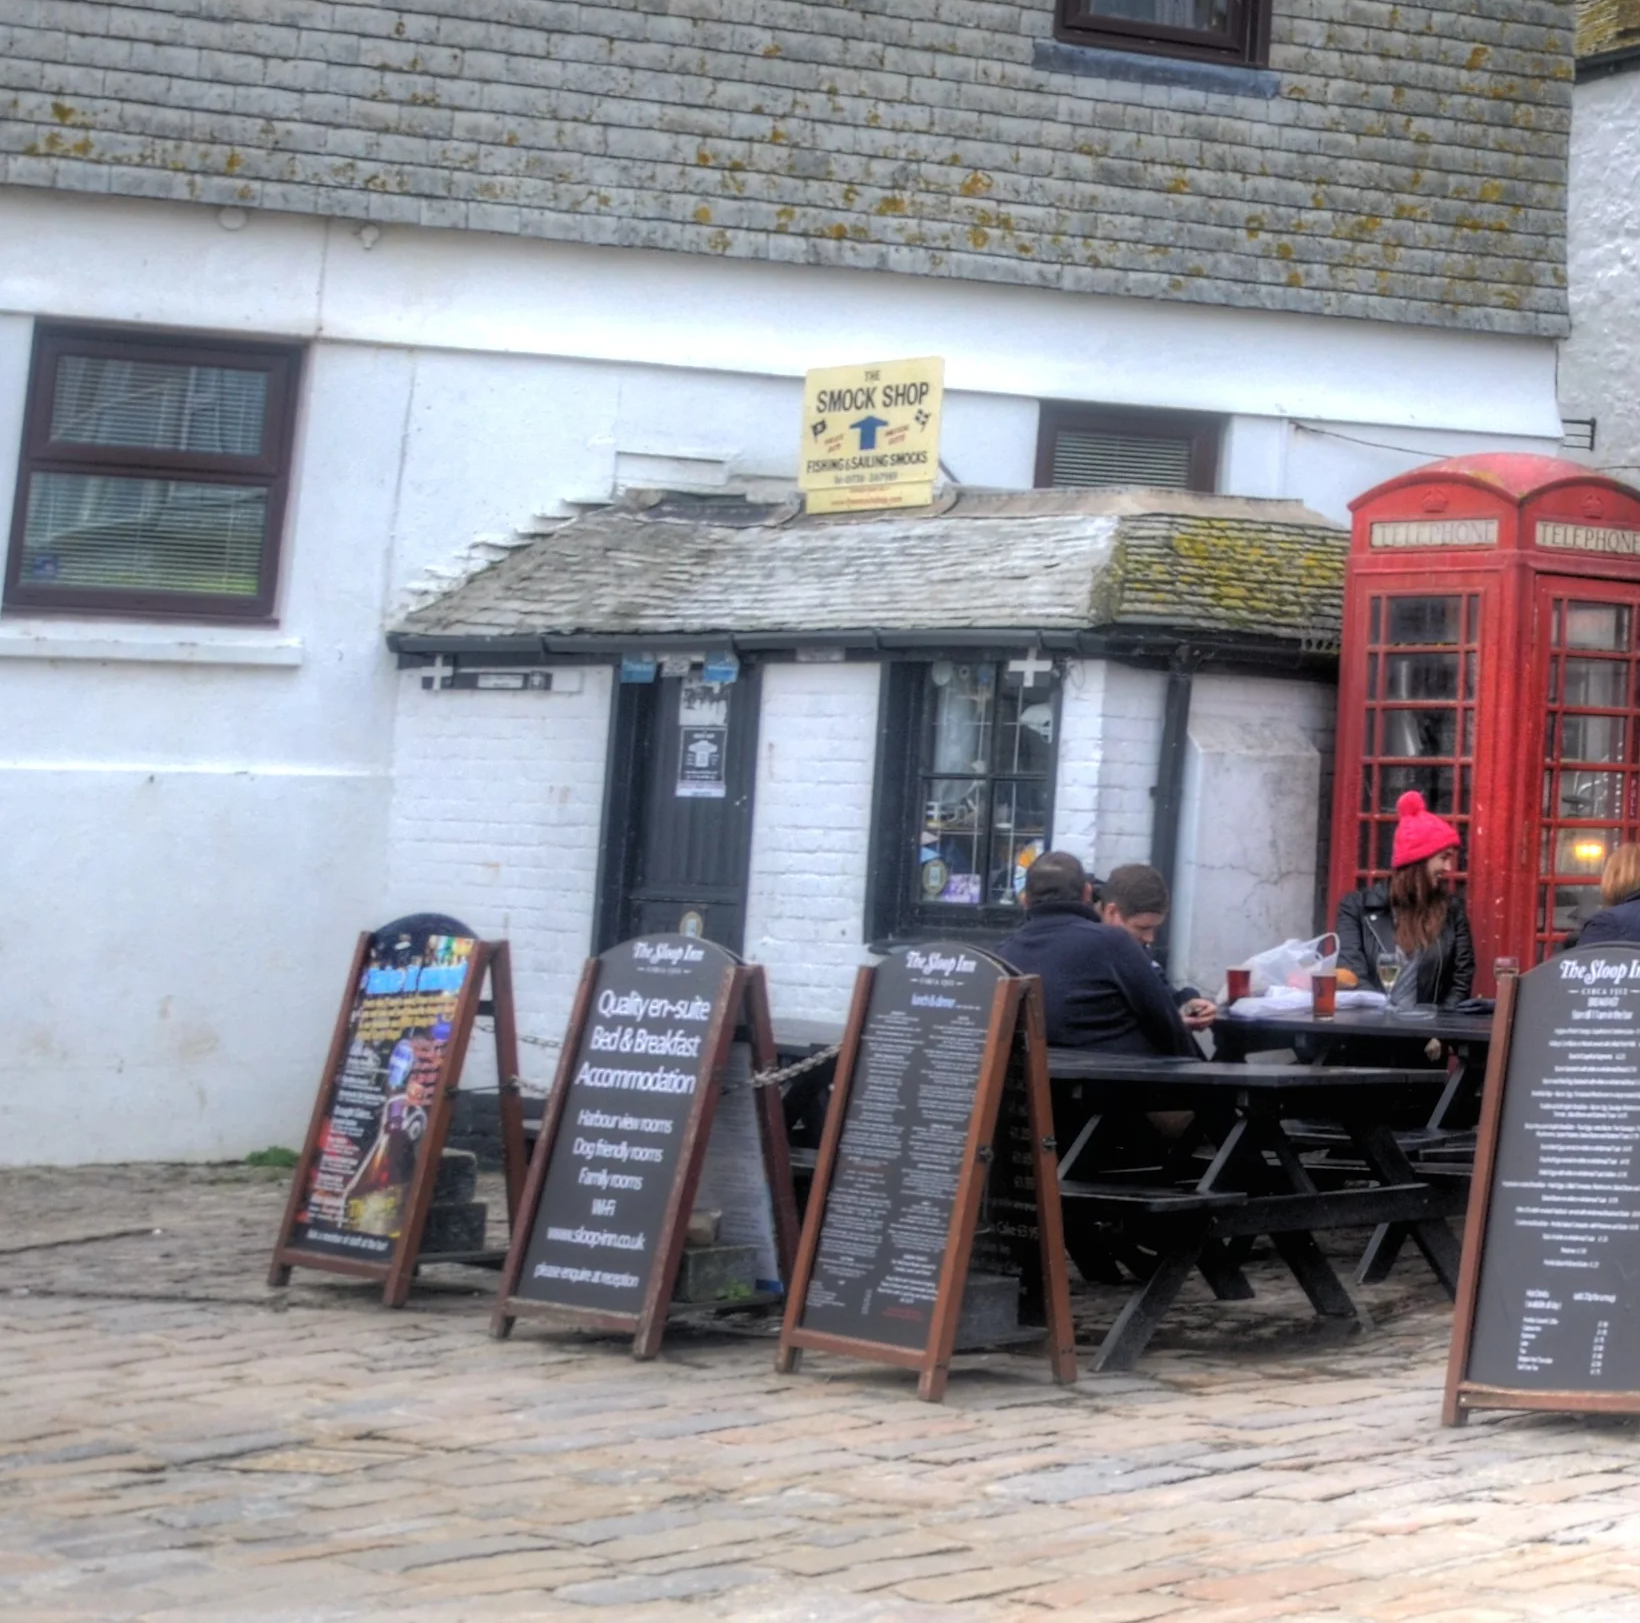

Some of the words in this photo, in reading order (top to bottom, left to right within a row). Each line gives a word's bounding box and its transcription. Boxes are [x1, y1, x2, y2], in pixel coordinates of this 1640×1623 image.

[864, 370, 880, 381] THE
[816, 387, 876, 413] SMOCK
[882, 382, 930, 408] SHOP
[807, 459, 845, 473] FISHING
[851, 455, 889, 469] SAILING
[890, 451, 927, 465] SMOCKS
[1379, 522, 1494, 545] TELEPHONE
[633, 942, 652, 959] The
[650, 943, 682, 965] Sloop
[1560, 959, 1587, 979] The
[1584, 959, 1628, 984] Sloop
[598, 989, 649, 1022] Quality
[590, 1026, 622, 1050] Bed
[619, 1027, 634, 1052] &
[634, 1029, 701, 1057] Breakfast
[574, 1061, 697, 1094] Accommodation
